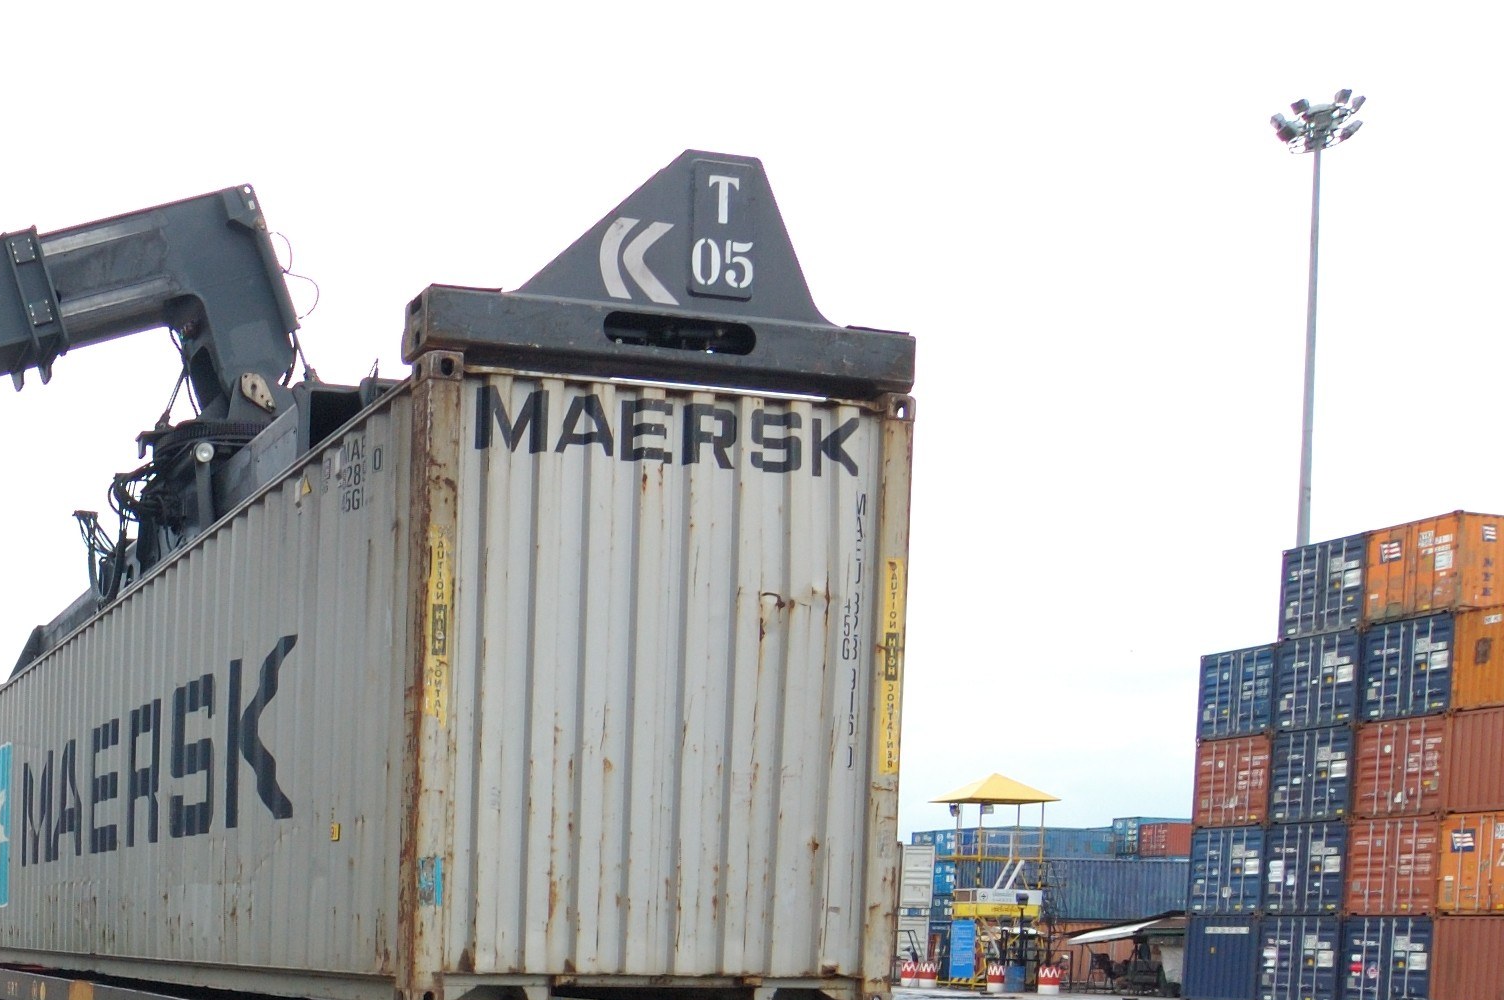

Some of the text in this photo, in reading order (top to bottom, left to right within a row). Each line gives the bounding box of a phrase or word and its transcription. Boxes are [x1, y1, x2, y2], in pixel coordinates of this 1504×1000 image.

[708, 175, 739, 224] T
[692, 238, 754, 288] 05
[474, 385, 860, 477] MAERSK
[21, 634, 298, 867] MAERSK
